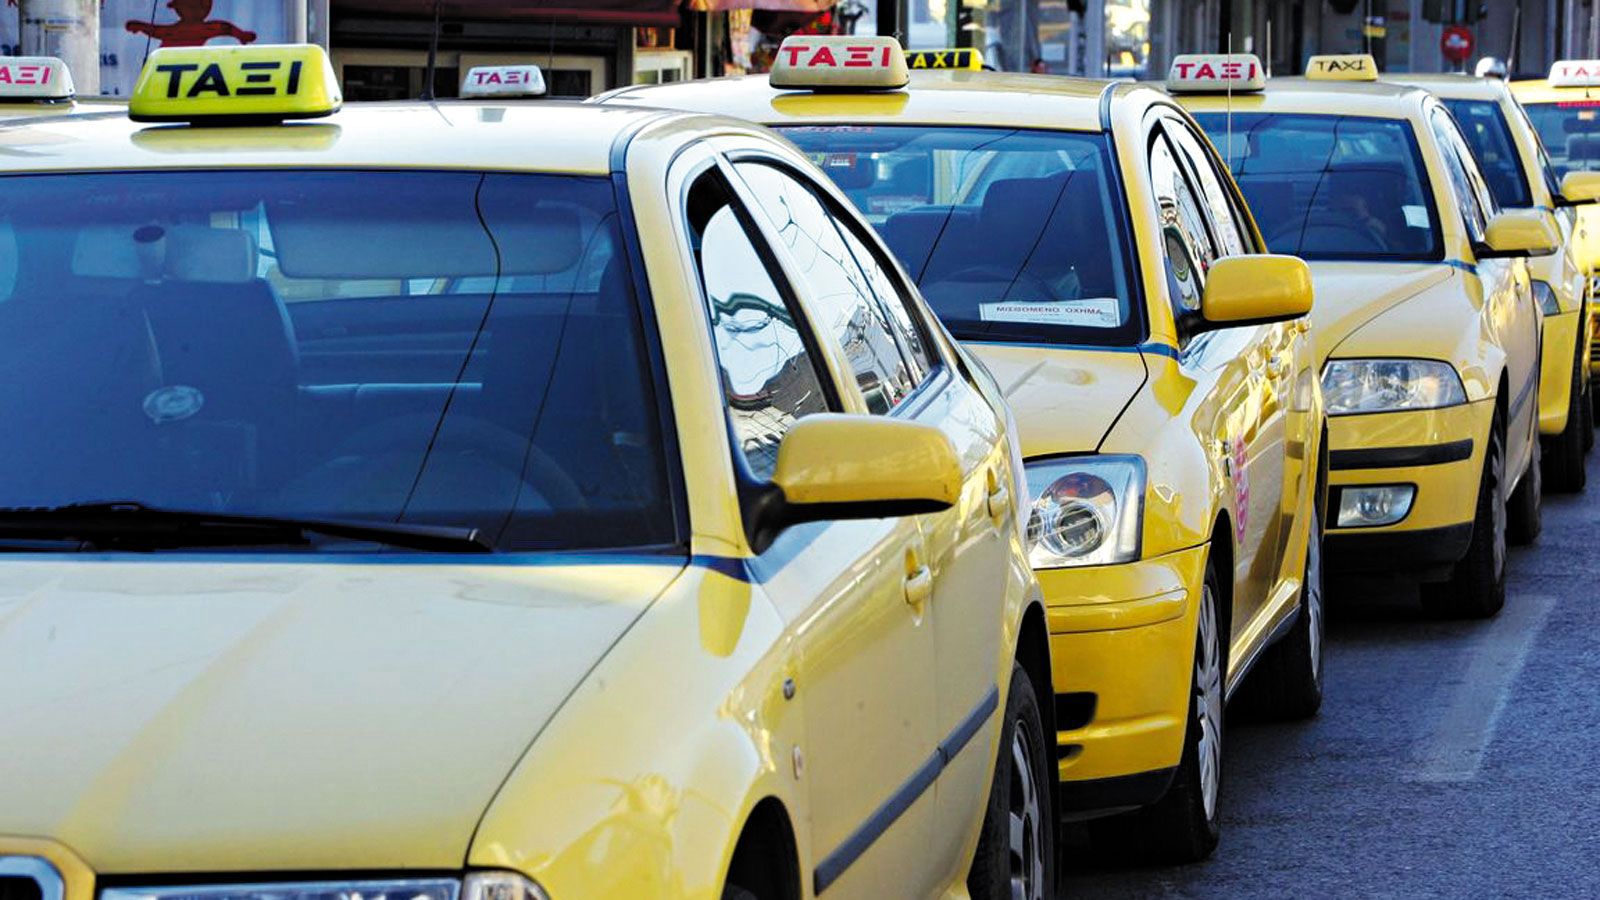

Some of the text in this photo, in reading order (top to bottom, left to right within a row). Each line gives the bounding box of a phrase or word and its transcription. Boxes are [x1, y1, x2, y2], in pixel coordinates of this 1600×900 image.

[782, 46, 891, 67] ΤΑΞΙ
[1175, 63, 1256, 80] ΤΑΞΙ
[1315, 60, 1364, 72] TAXI
[1561, 66, 1600, 77] ΤΑ
[0, 66, 51, 84] ΑΞΙ
[156, 61, 303, 98] ΤΑΞΙ
[473, 71, 530, 85] ΤΑΞΙ
